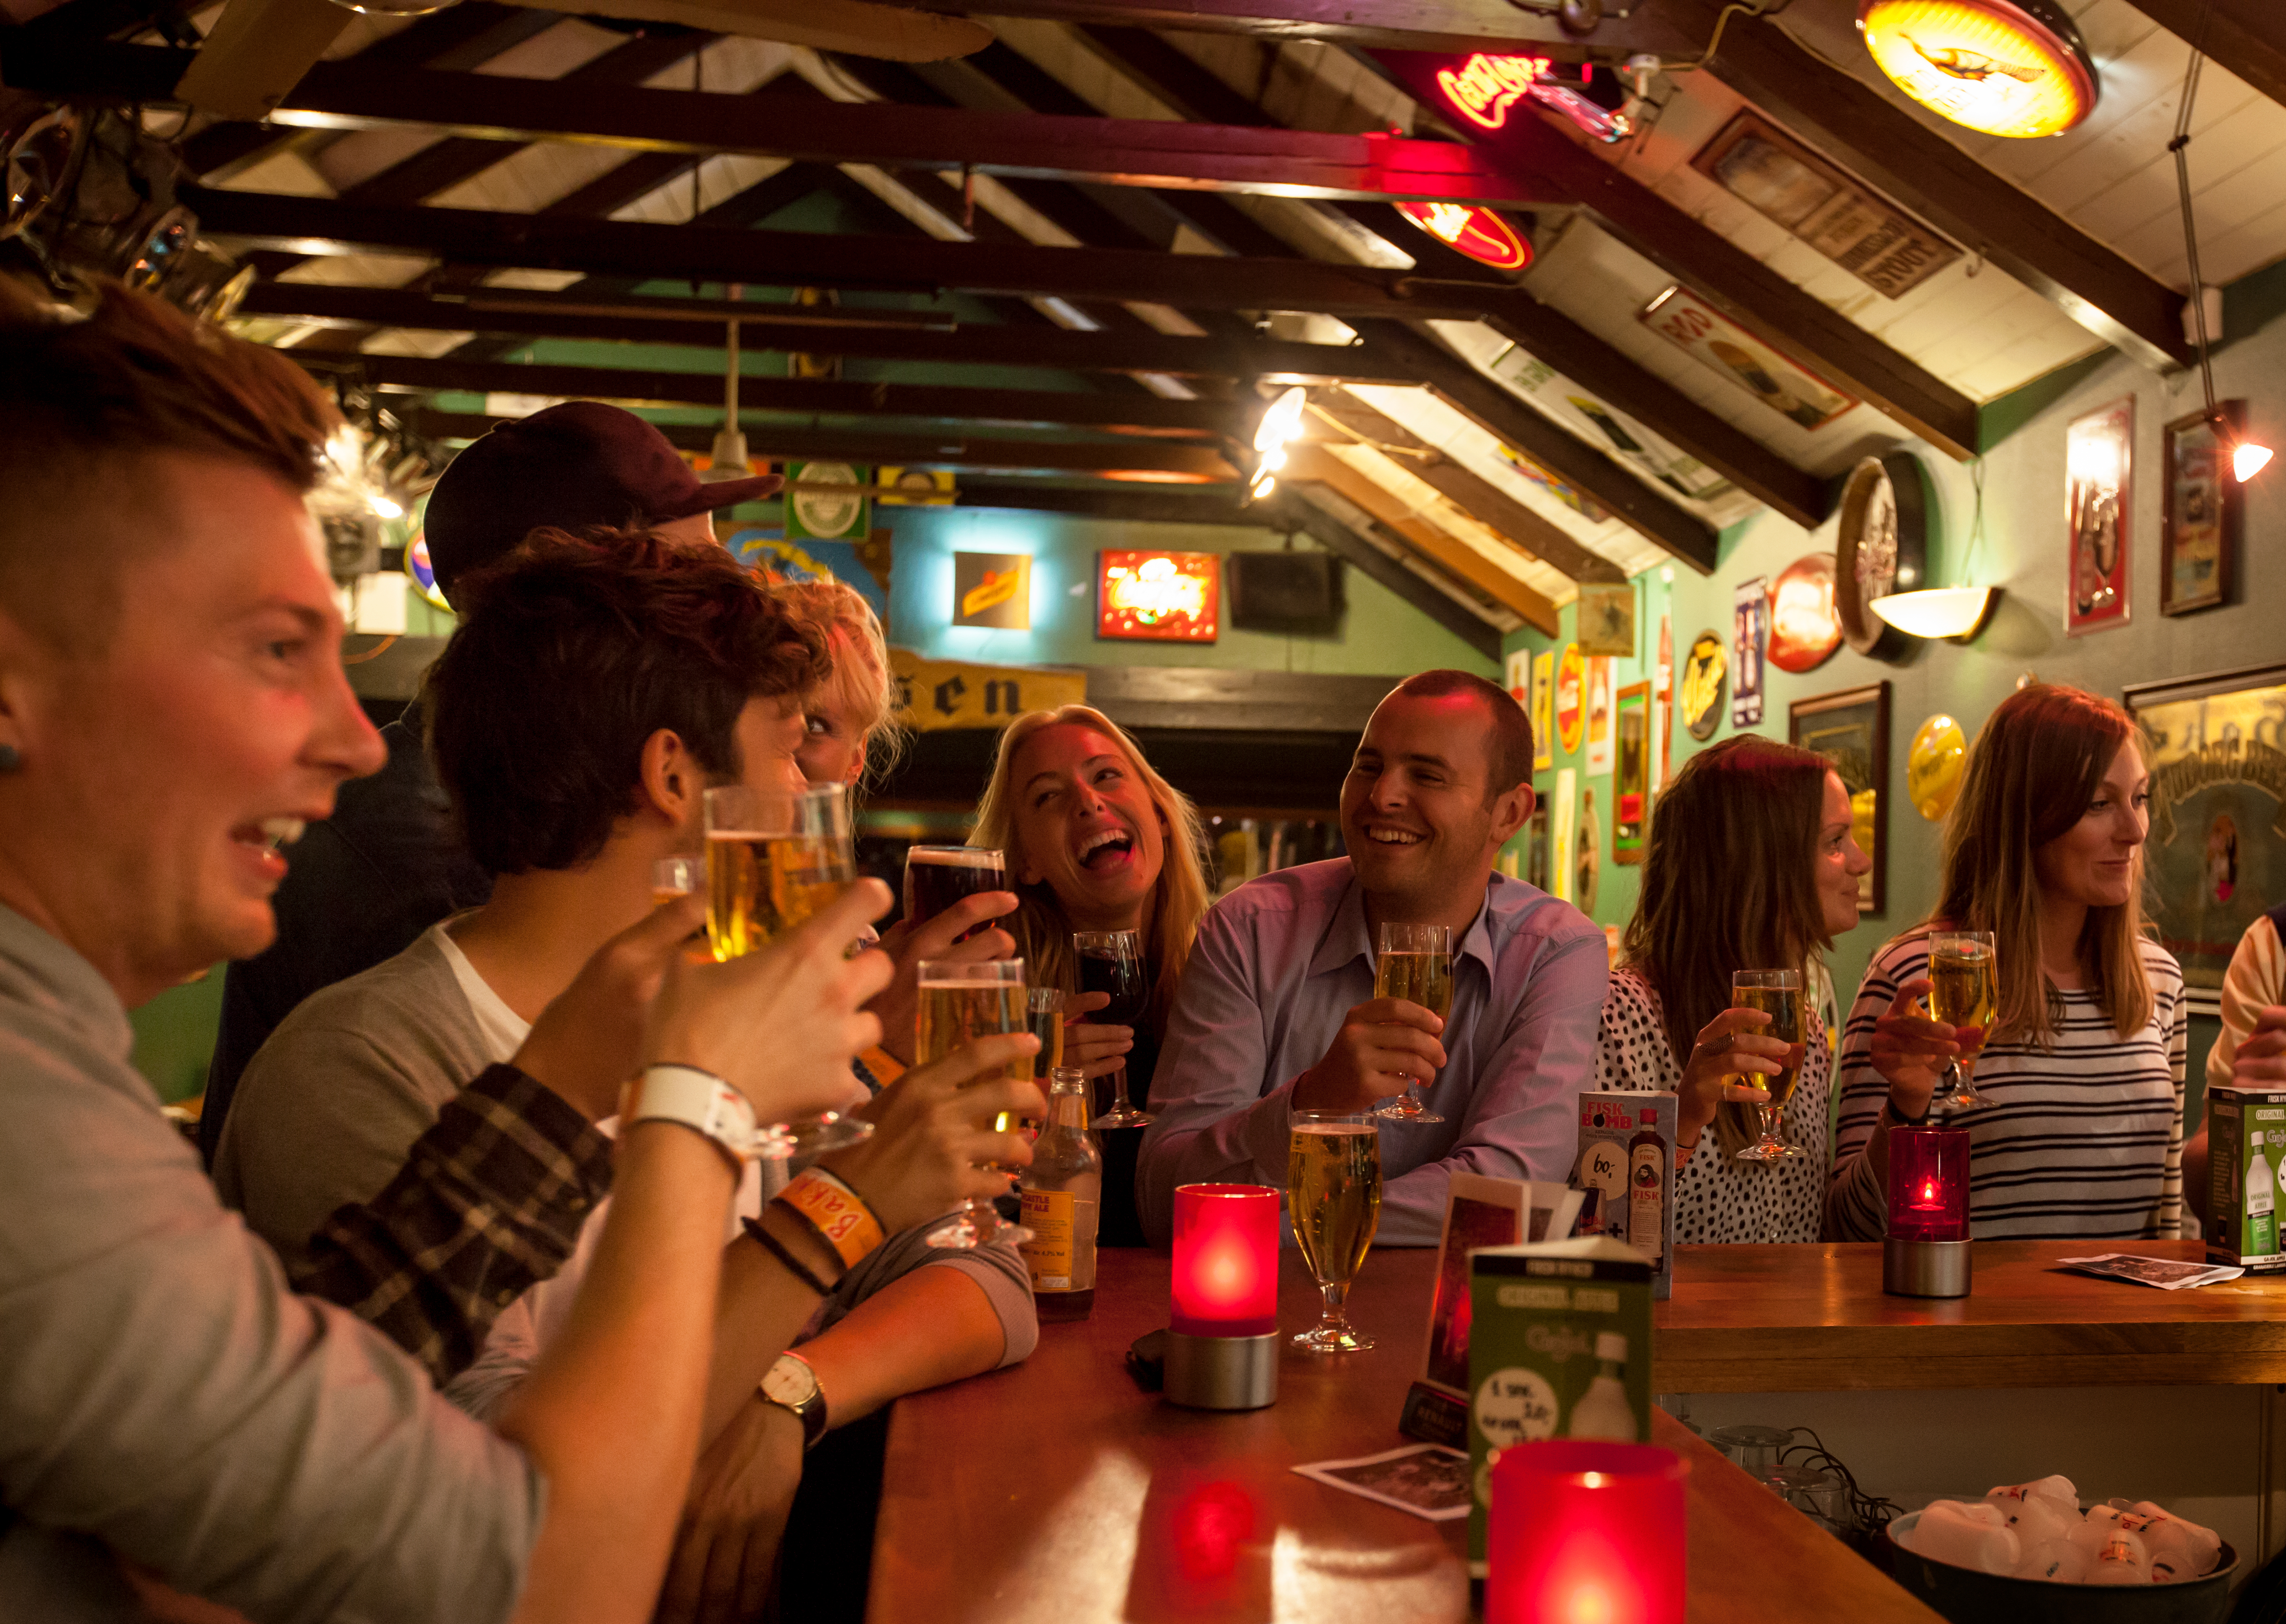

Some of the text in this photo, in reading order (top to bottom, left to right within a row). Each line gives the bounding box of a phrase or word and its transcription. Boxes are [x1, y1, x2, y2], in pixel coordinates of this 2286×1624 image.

[1587, 1102, 1624, 1115] FISK
[2256, 1110, 2284, 1119] ORIGINAL
[1582, 1113, 1633, 1129] BOMB
[1634, 1190, 1658, 1200] FISK
[1034, 1204, 1049, 1212] ALE
